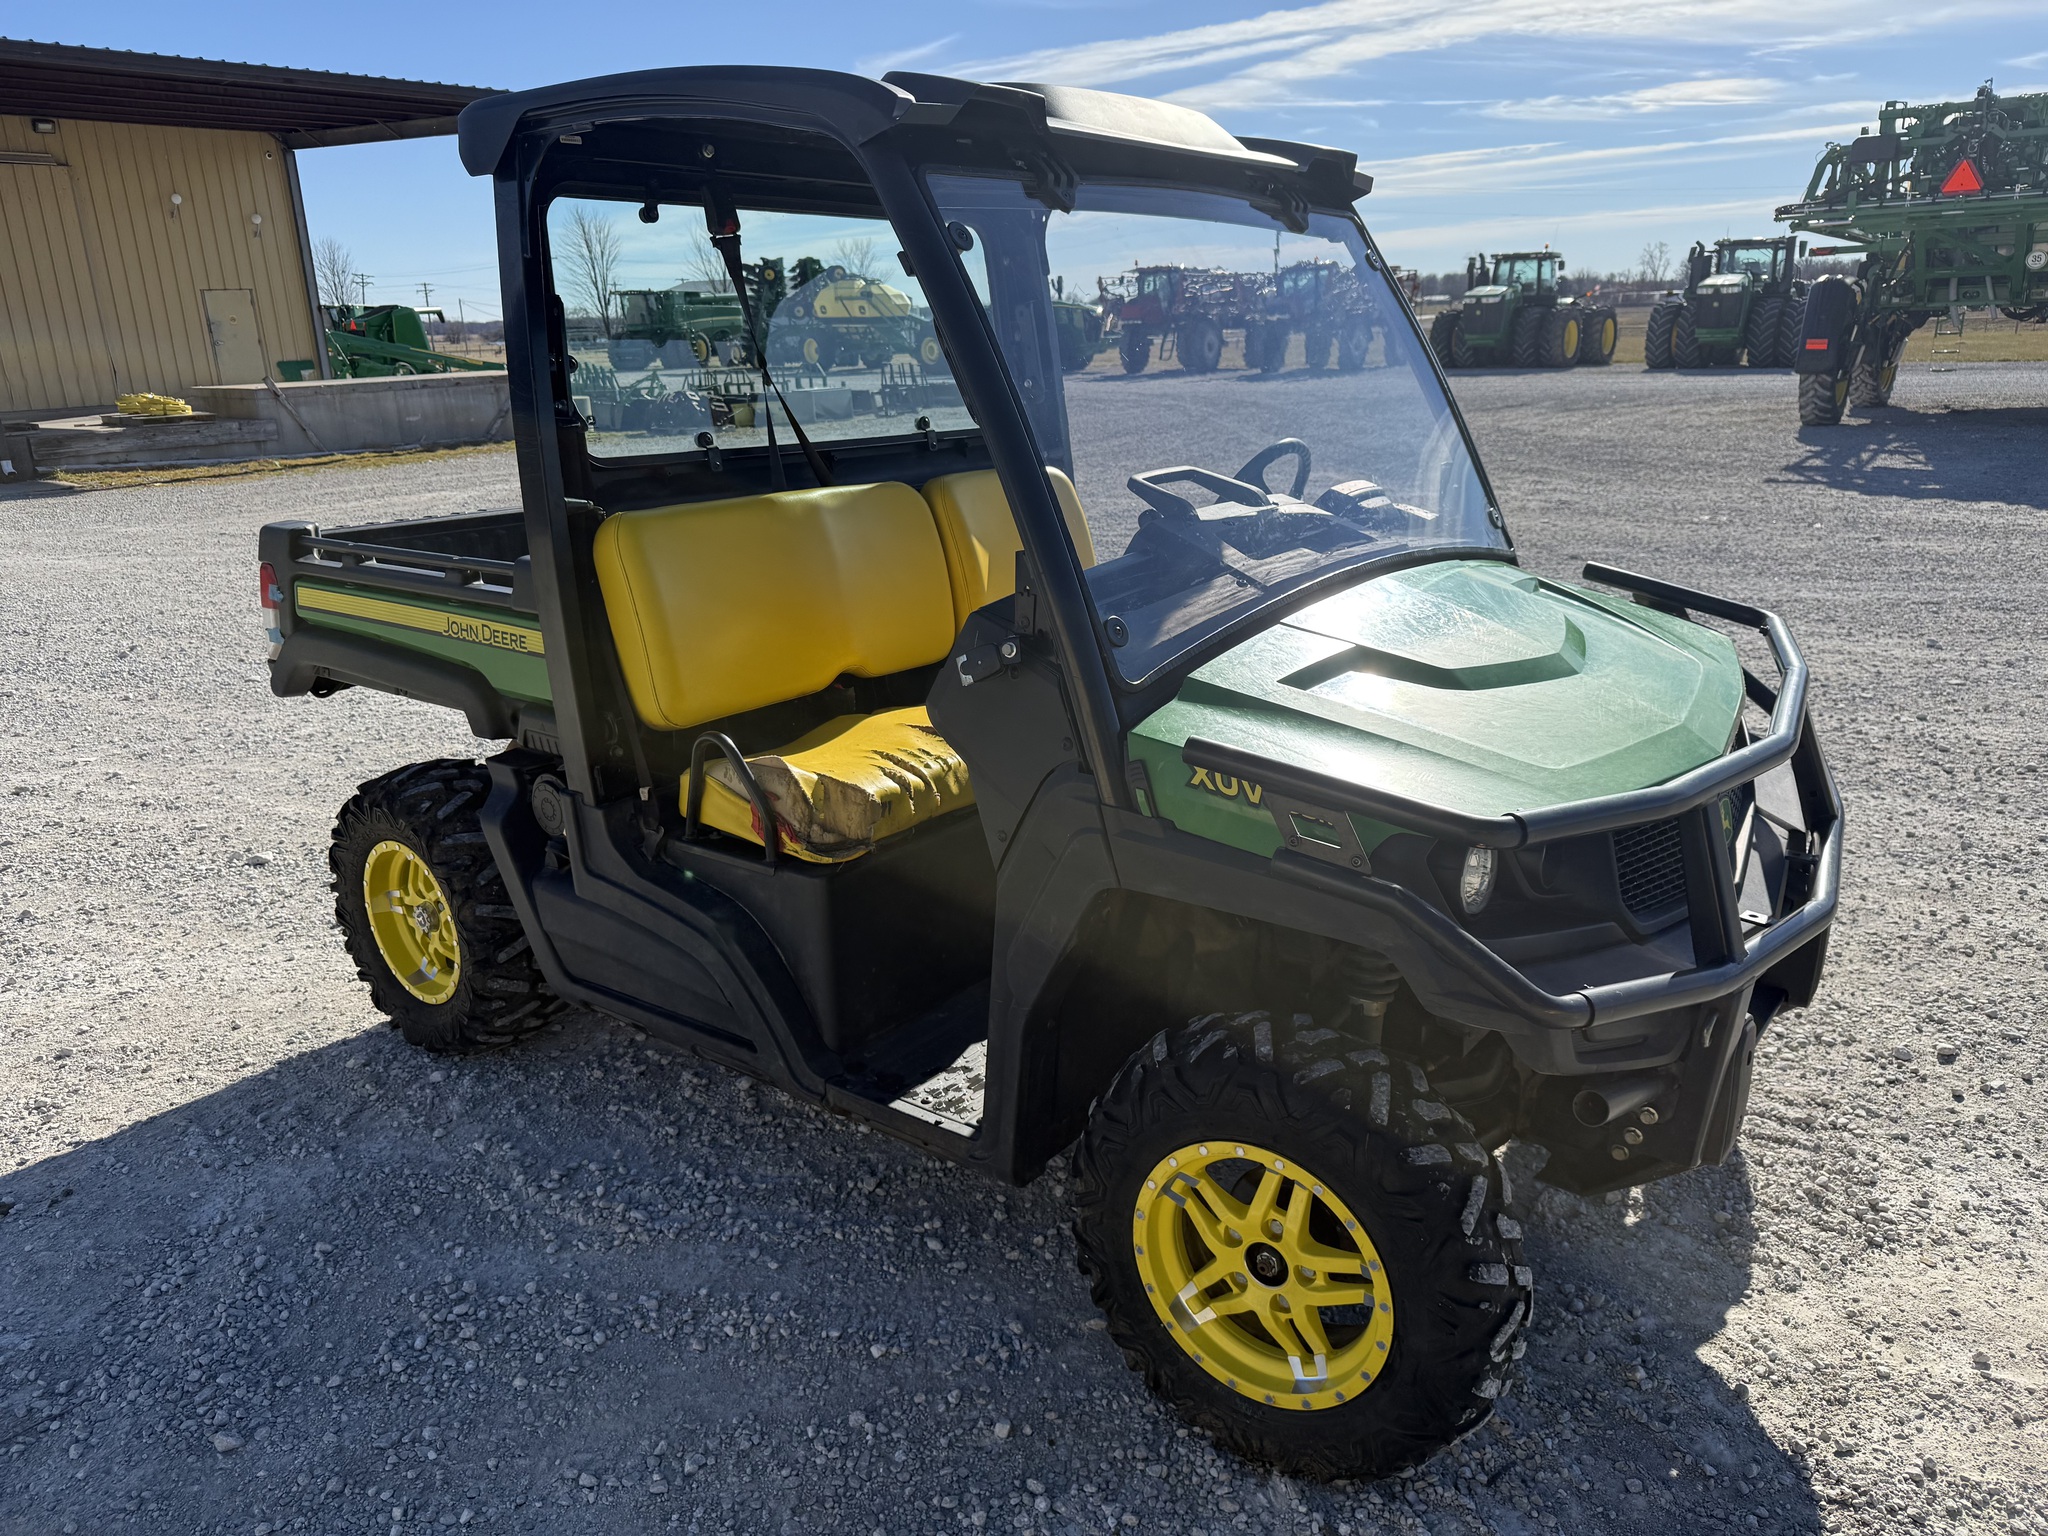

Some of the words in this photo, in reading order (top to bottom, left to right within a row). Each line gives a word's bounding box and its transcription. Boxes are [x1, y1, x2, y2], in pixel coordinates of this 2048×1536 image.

[443, 616, 480, 640] JOHN
[481, 623, 529, 651] DEERE
[1189, 765, 1264, 805] XUV
